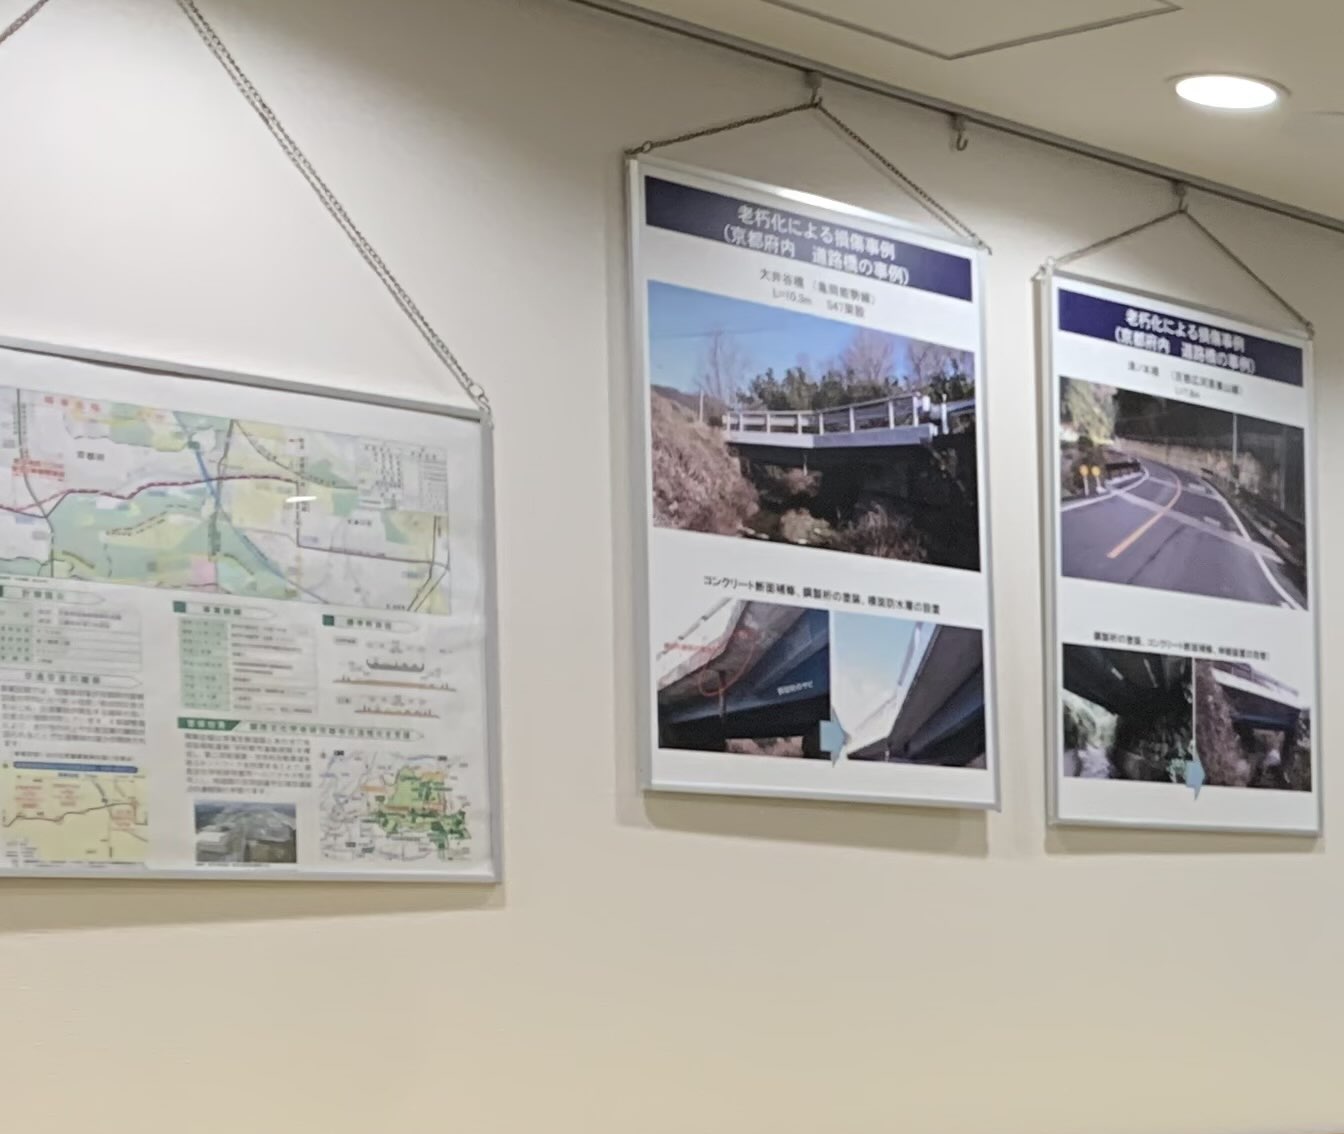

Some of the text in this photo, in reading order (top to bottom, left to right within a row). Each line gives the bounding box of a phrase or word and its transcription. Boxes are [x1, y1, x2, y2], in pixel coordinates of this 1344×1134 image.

[738, 204, 896, 261] 老朽化による損傷事例
